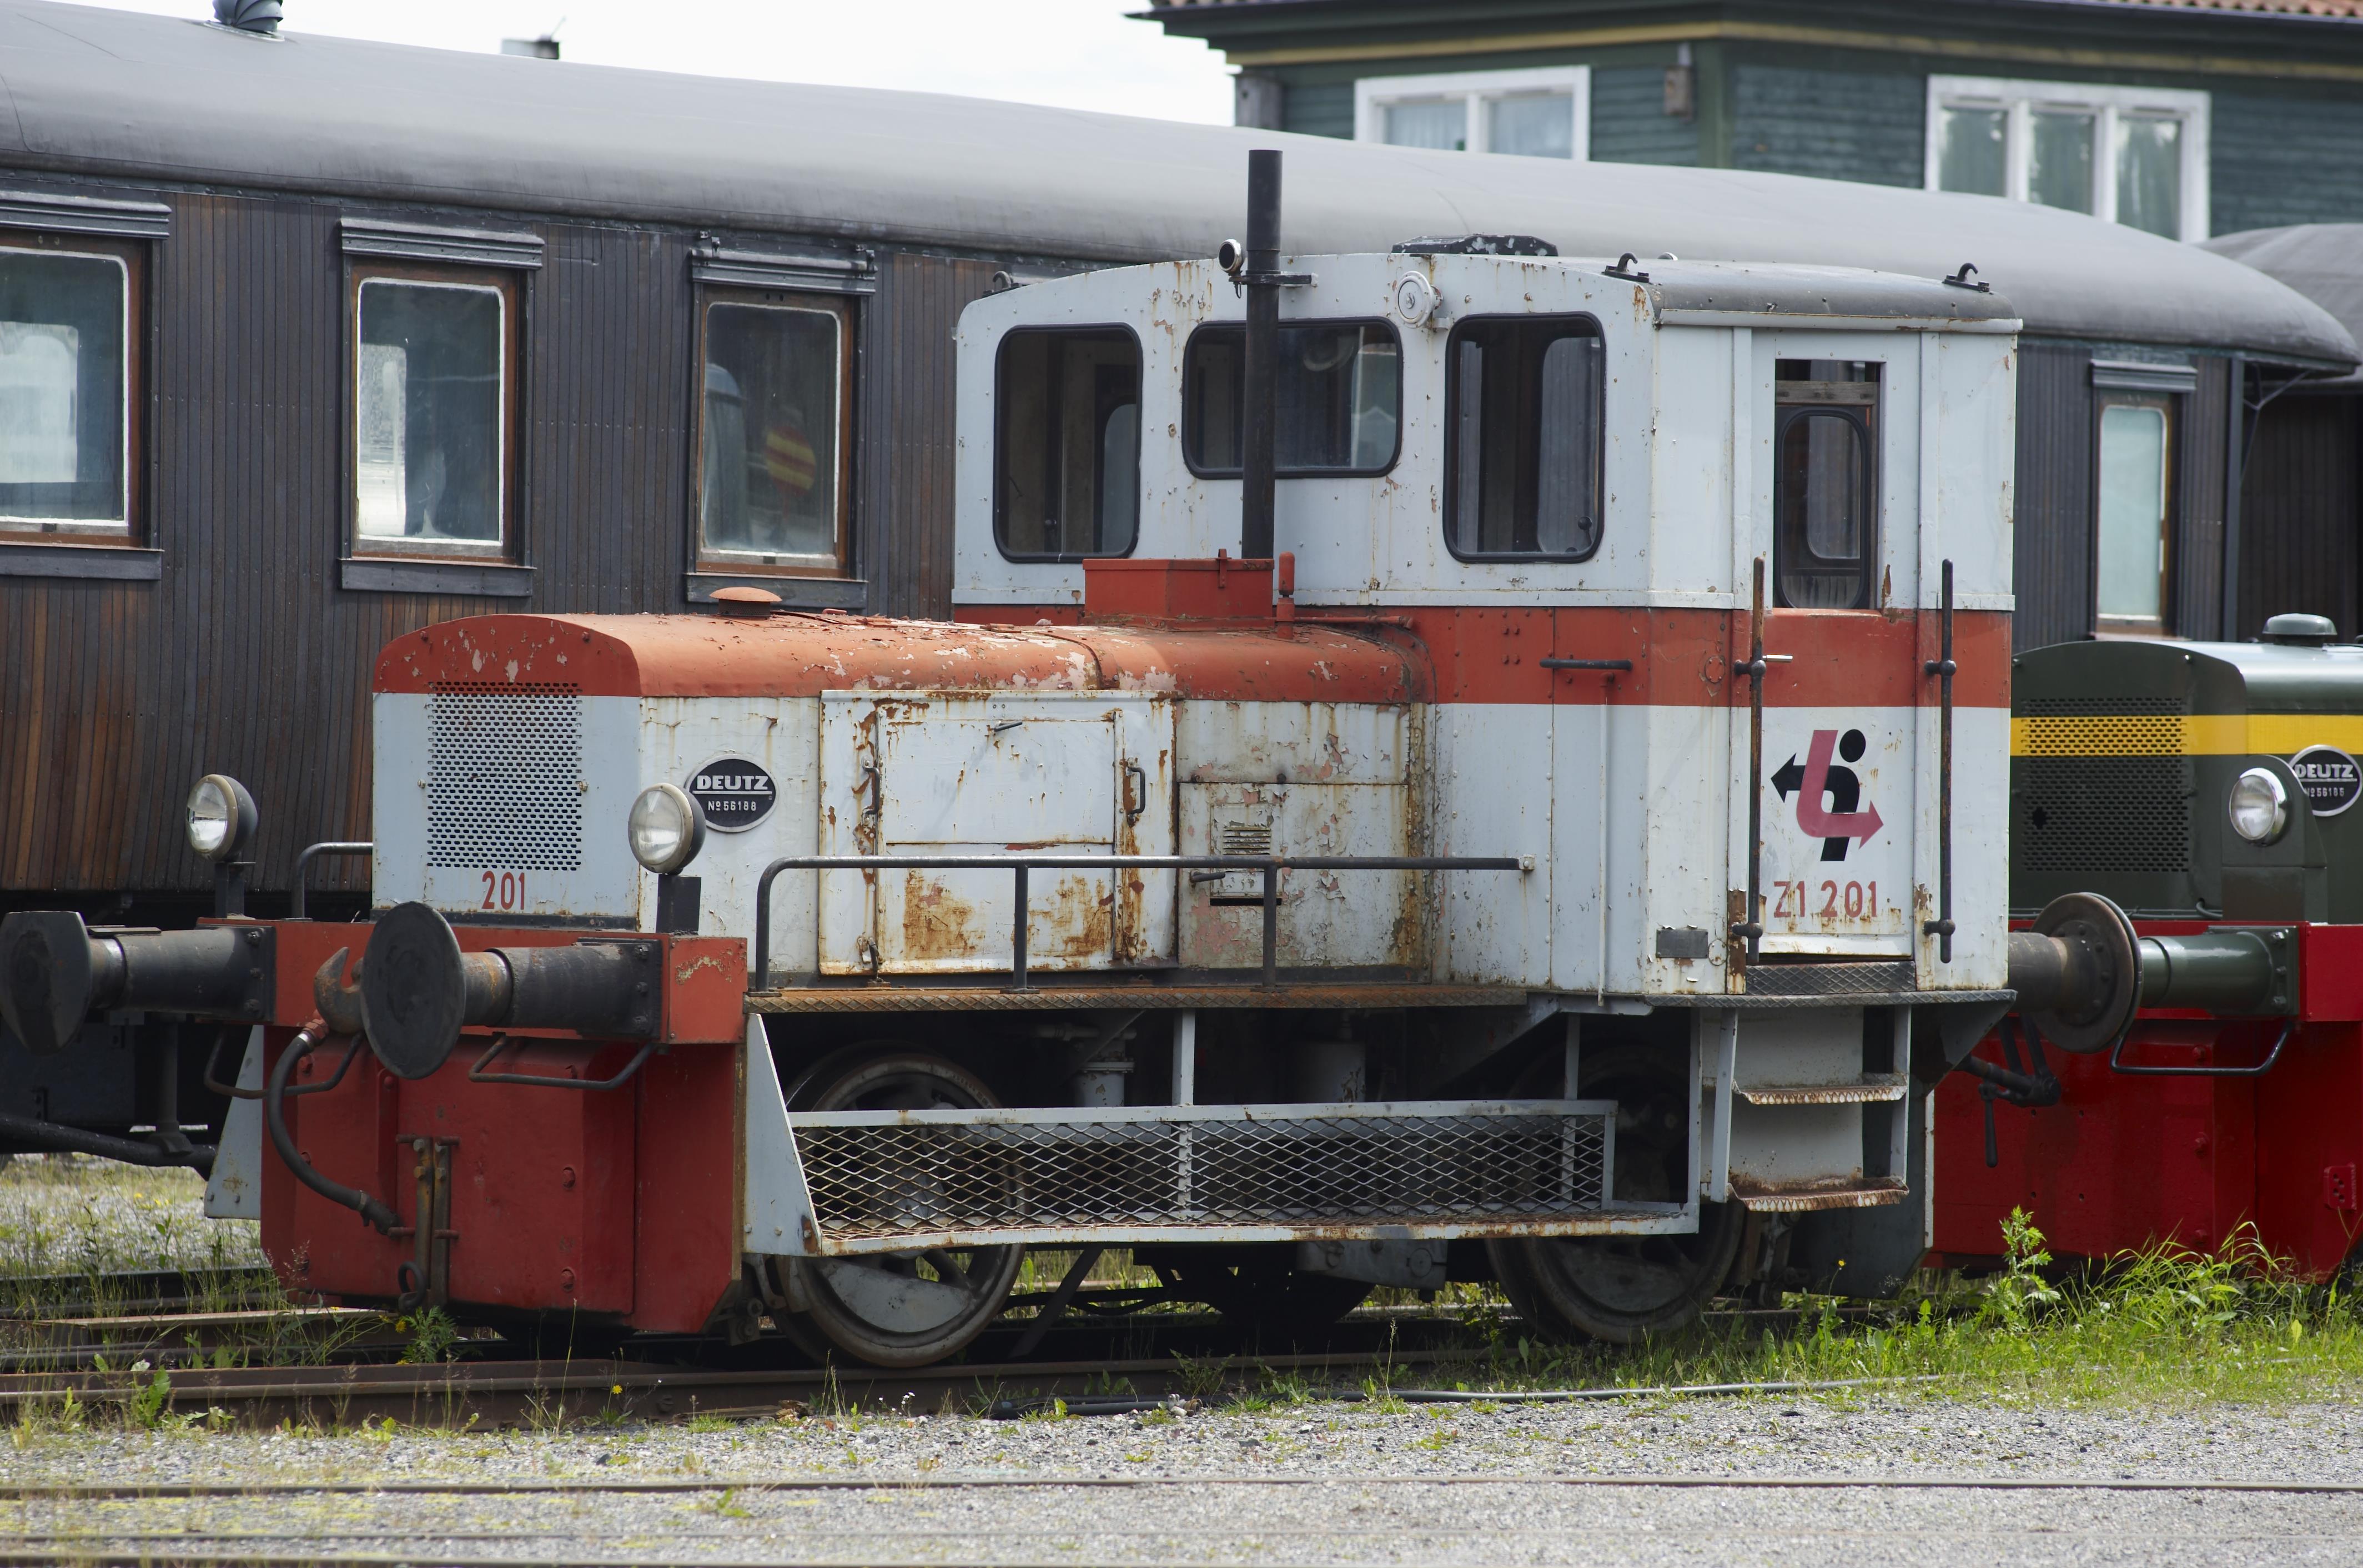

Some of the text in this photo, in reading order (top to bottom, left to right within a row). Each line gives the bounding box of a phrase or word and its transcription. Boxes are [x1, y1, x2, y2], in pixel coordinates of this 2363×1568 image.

[2295, 763, 2354, 778] DEUTZ
[697, 775, 768, 790] DEUTZ
[723, 801, 756, 811] 56188
[481, 870, 525, 910] 201
[1773, 880, 1877, 918] Z1 201
